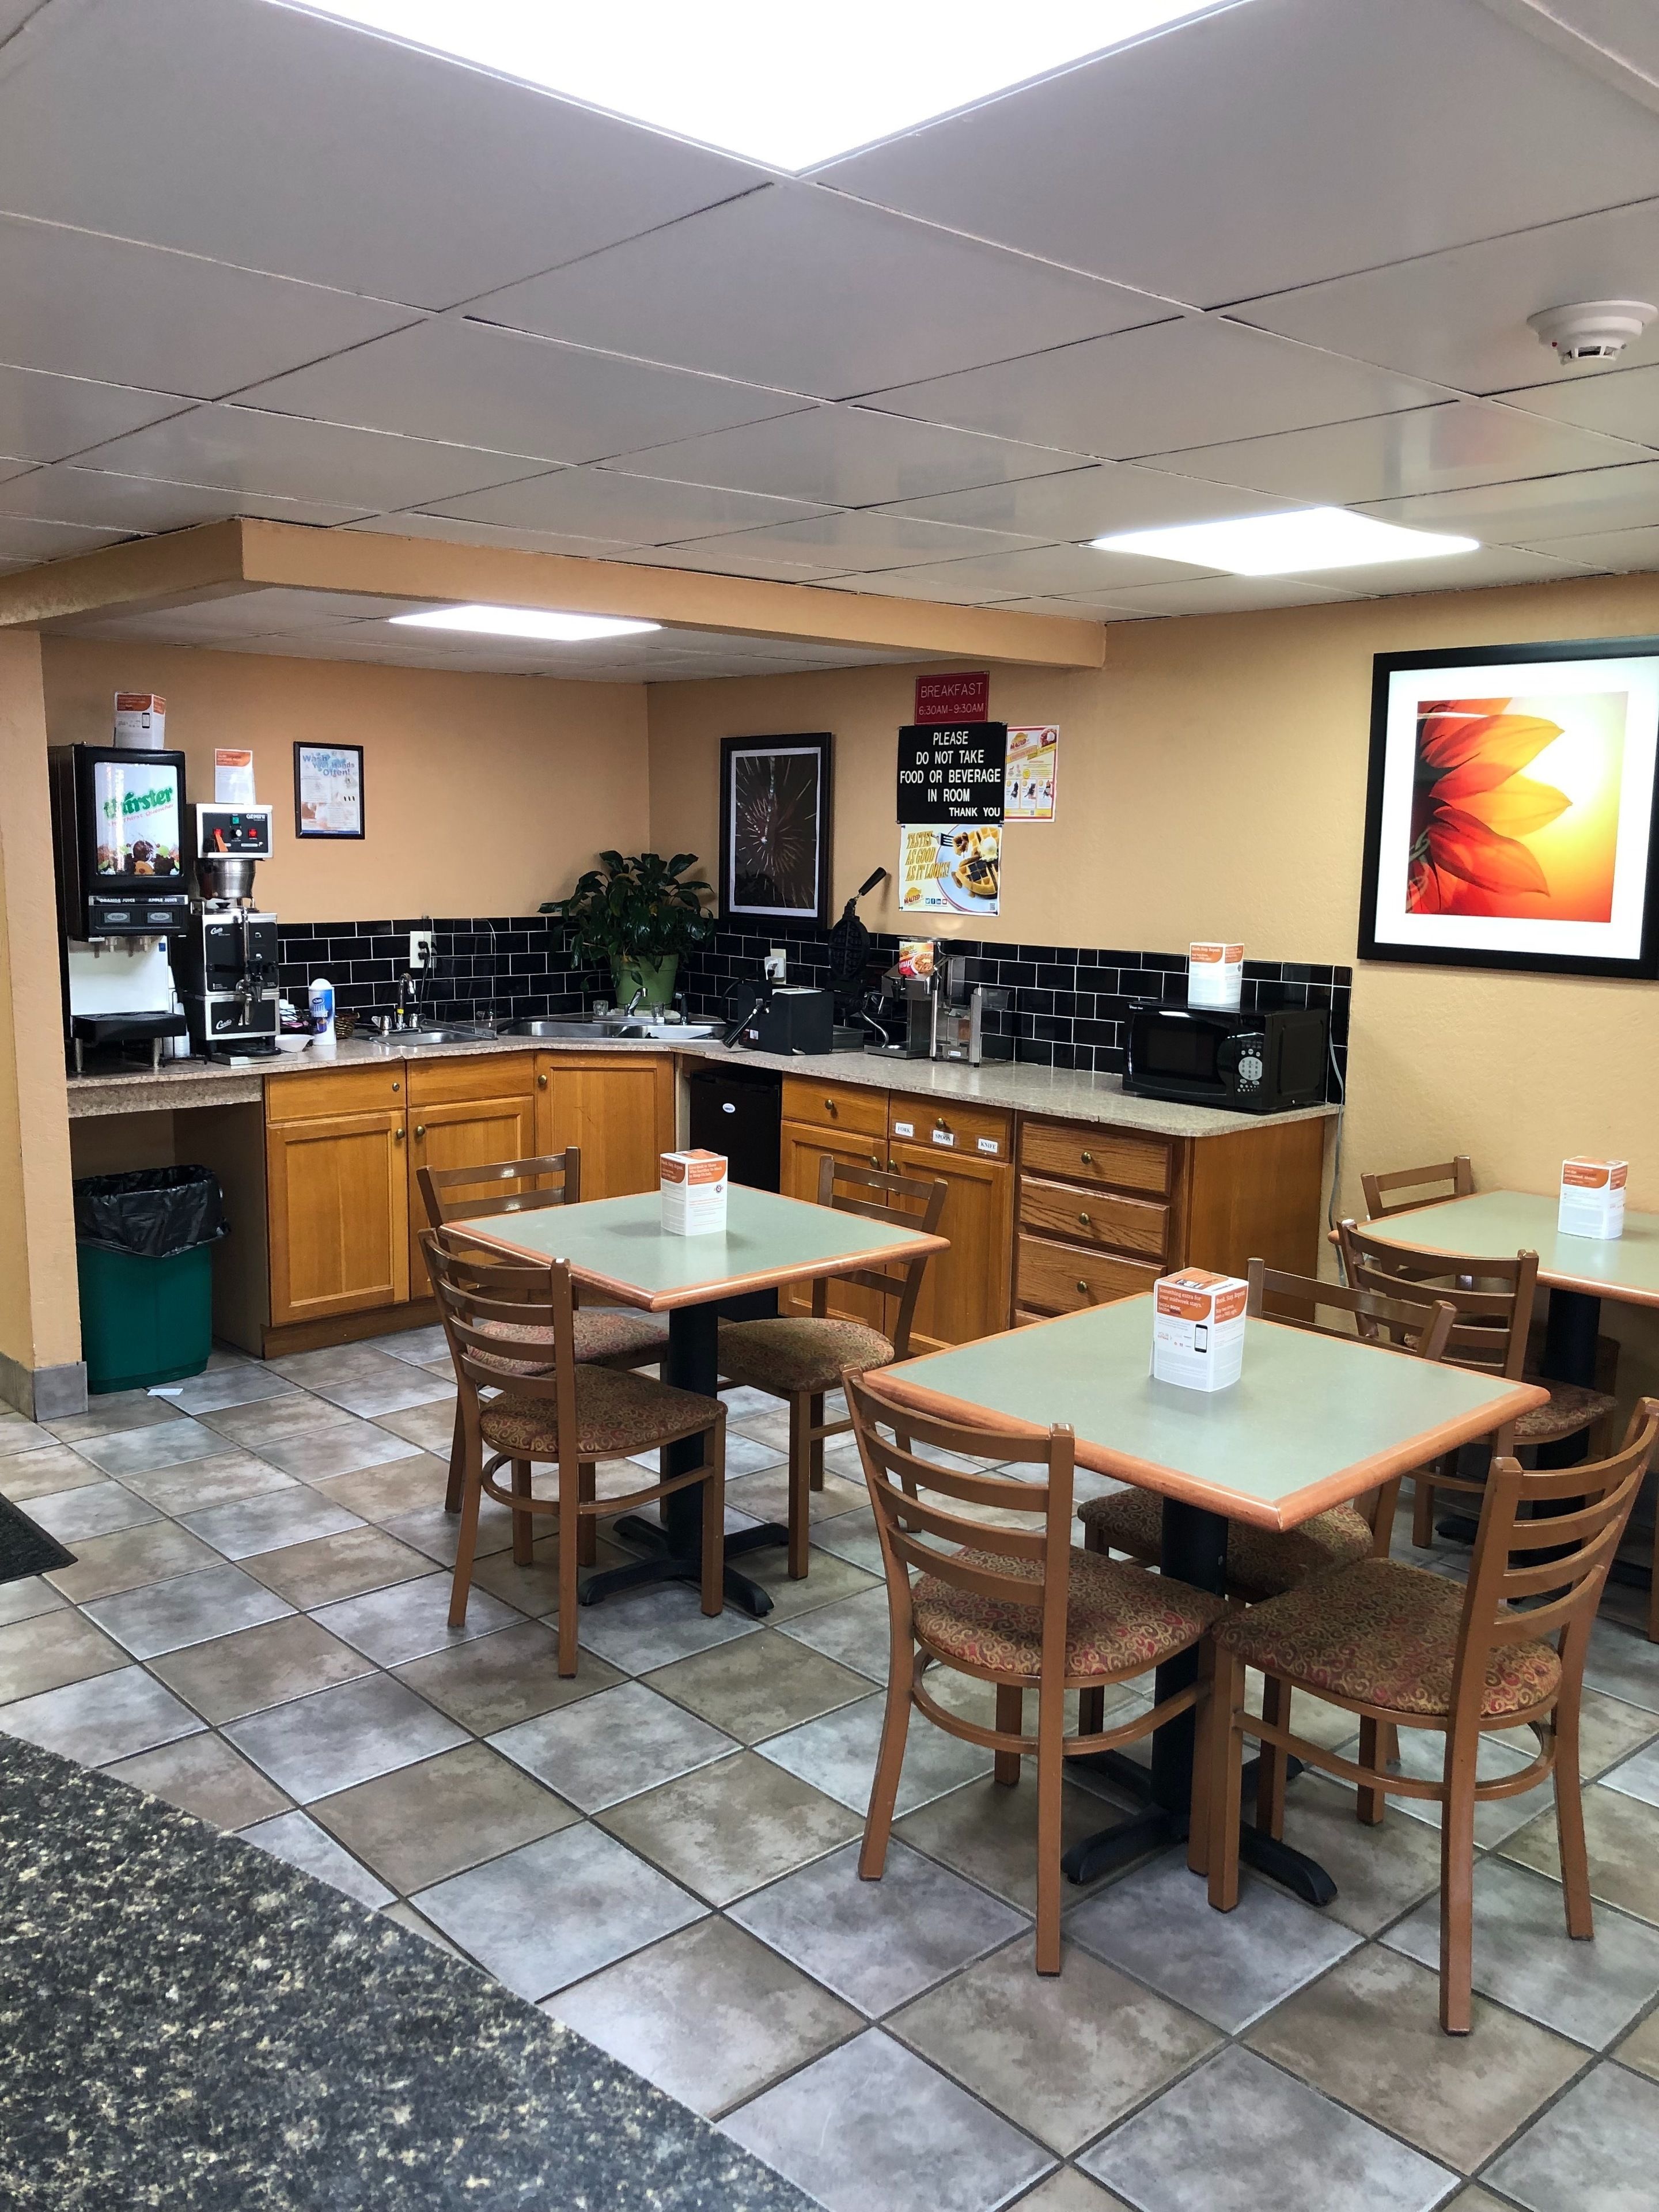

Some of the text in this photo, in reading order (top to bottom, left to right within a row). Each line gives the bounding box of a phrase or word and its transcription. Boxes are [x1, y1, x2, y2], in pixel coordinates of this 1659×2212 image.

[921, 682, 983, 698] BREAKFAST
[919, 703, 984, 715] 6:30AM-9:30AM
[933, 731, 969, 745] PLEASE
[916, 749, 985, 765] DO NOT TAKE
[900, 768, 1001, 783] FOOD OR BEVERAGE
[927, 788, 970, 802] IN ROOM
[949, 807, 978, 817] THANK
[983, 807, 1001, 817] YOU
[905, 847, 935, 865] AS GOOD
[906, 865, 917, 881] AS
[915, 865, 926, 881] IT
[935, 1134, 950, 1142] SPOON
[1159, 1287, 1181, 1298] Something
[1169, 1296, 1190, 1305] midweek
